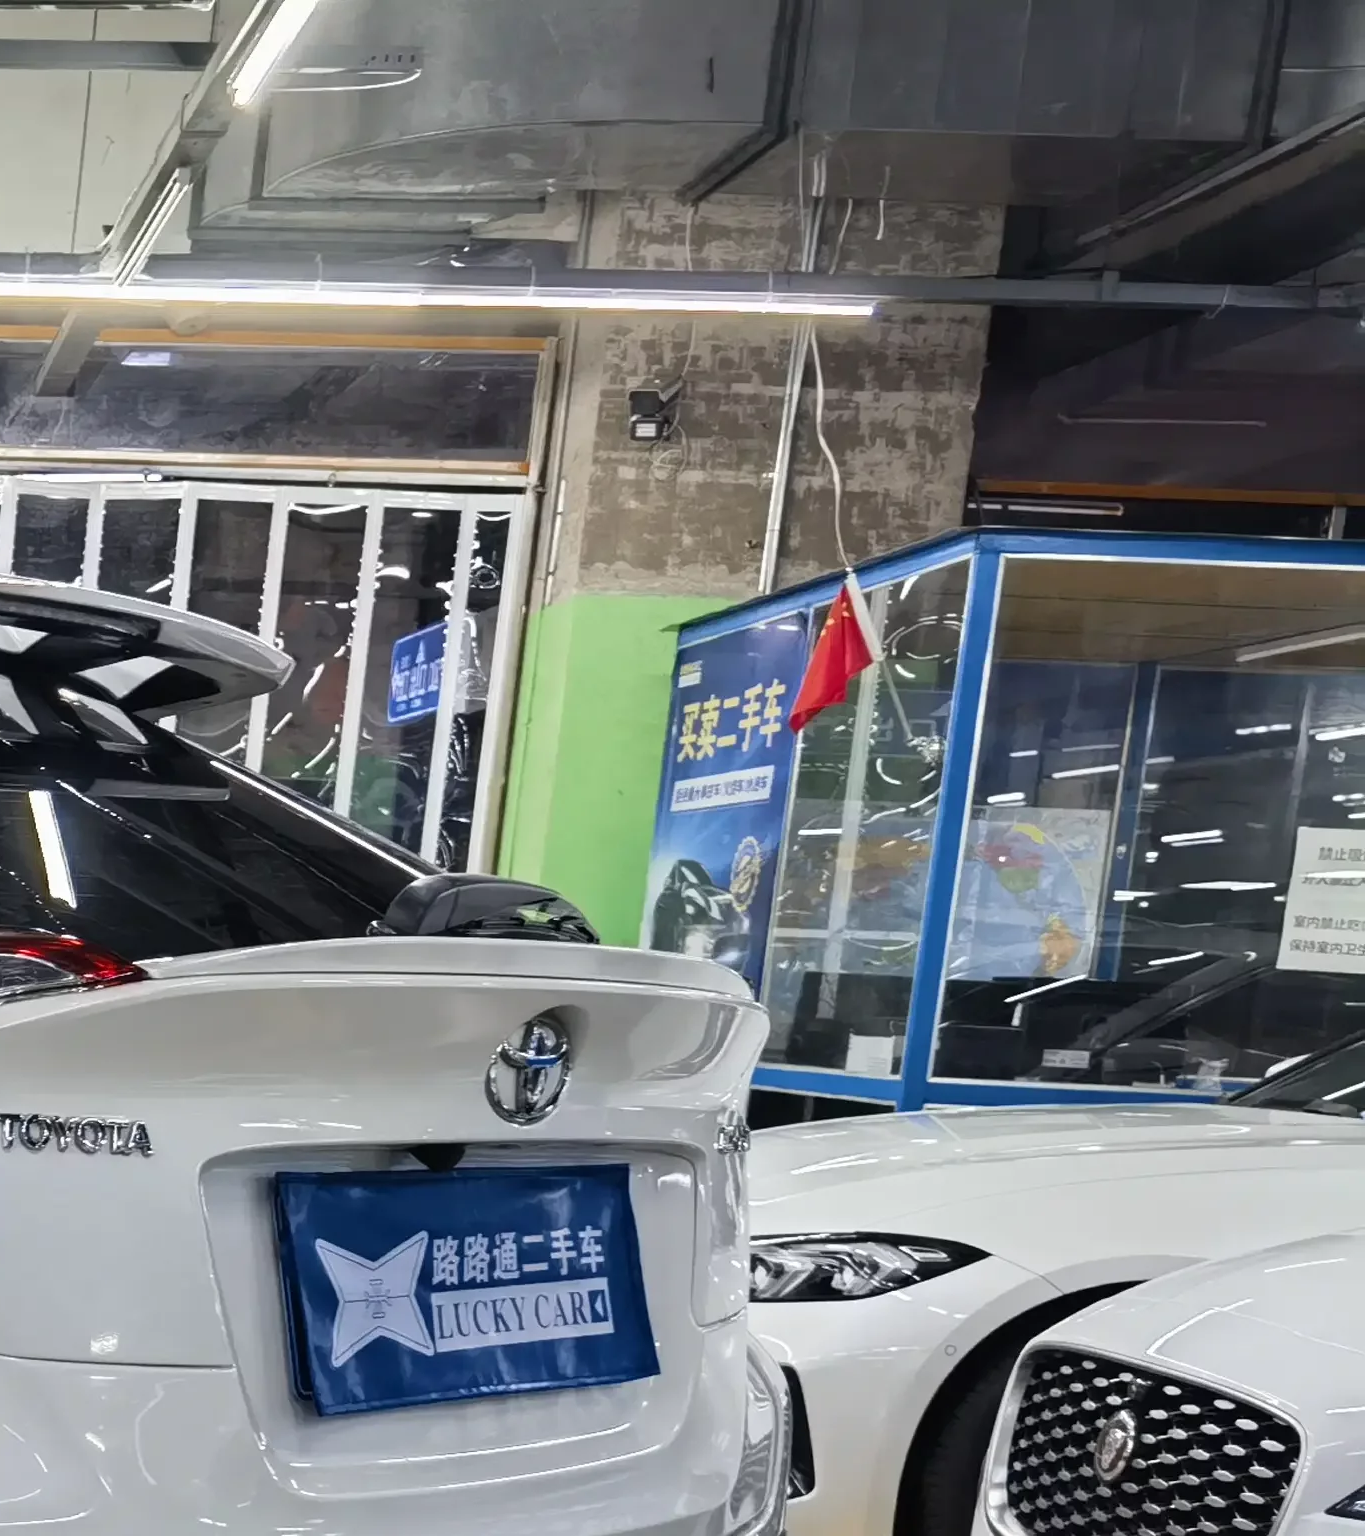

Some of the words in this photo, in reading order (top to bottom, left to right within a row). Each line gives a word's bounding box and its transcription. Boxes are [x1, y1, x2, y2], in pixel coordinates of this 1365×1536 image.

[677, 678, 786, 762] 买卖二手车
[1318, 846, 1365, 861] 禁止吸
[1293, 915, 1365, 931] 室内禁止吃
[432, 1225, 605, 1286] 路路通二手车
[436, 1296, 526, 1340] LUCKY
[534, 1291, 589, 1329] CAR
